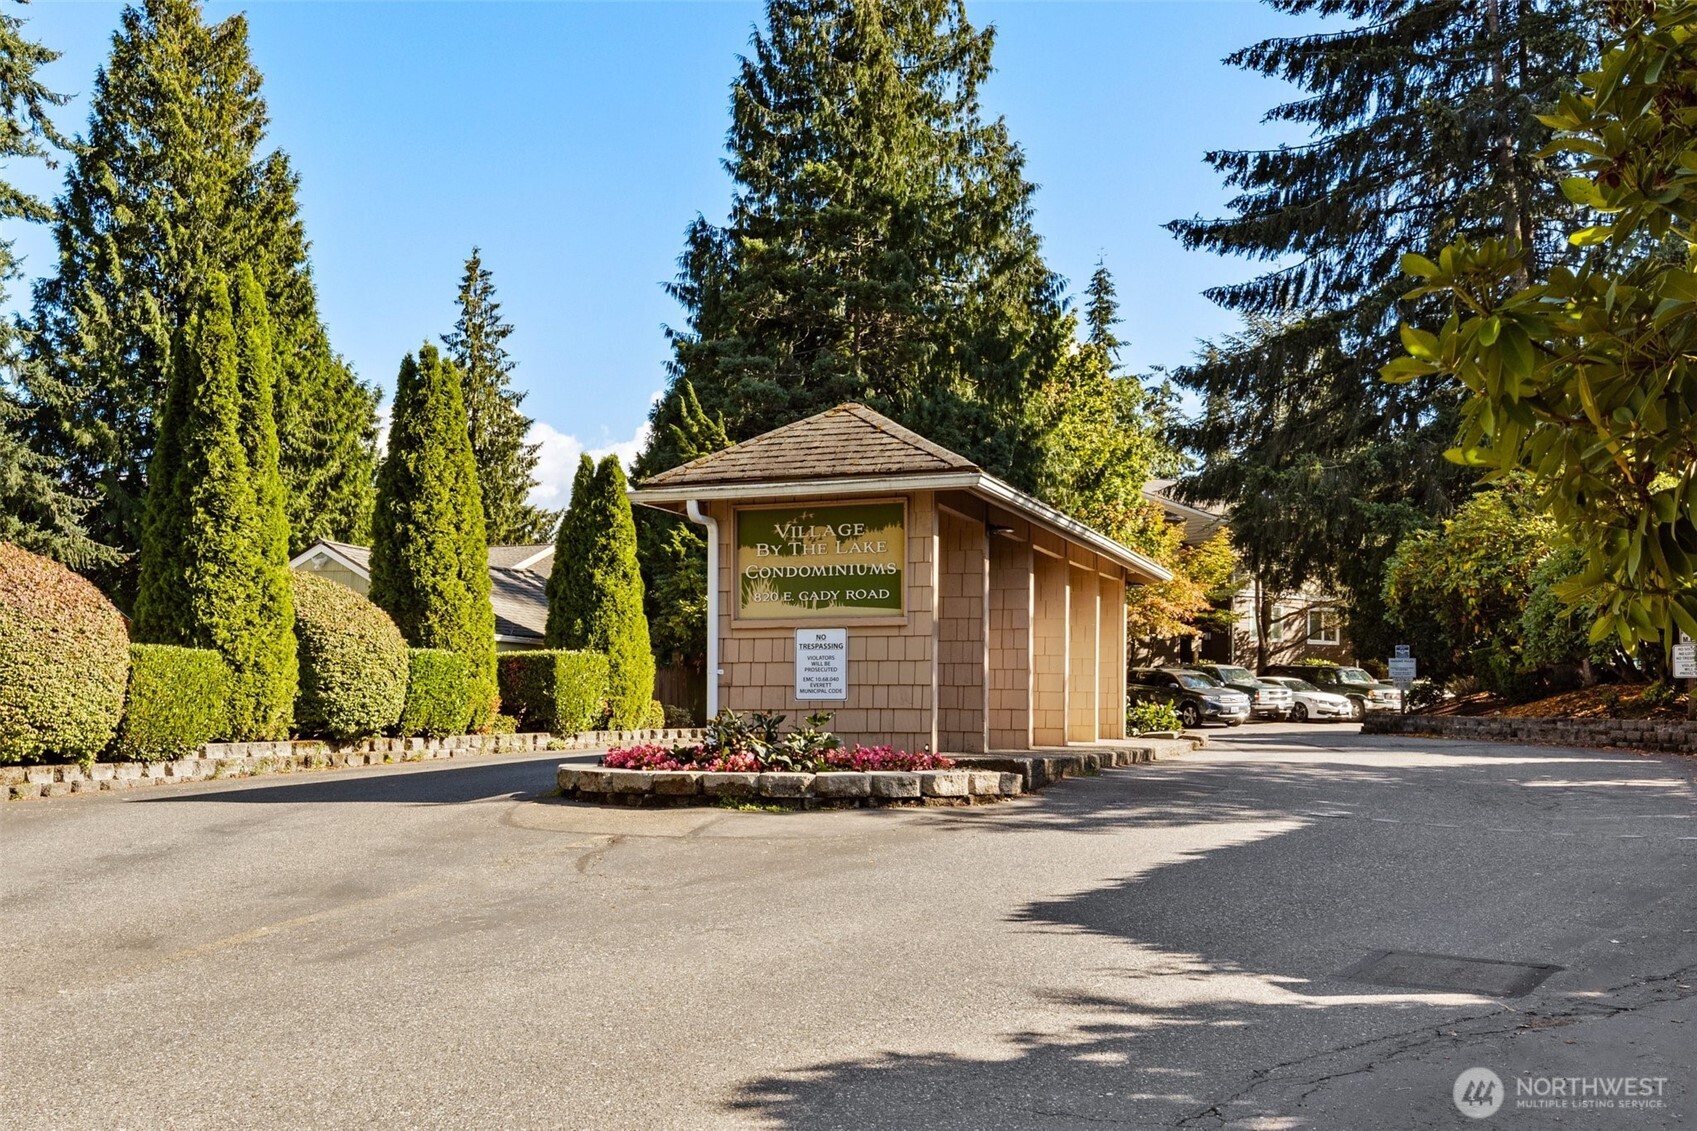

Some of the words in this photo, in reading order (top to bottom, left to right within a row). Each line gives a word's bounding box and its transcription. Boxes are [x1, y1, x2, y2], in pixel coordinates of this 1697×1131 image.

[774, 523, 865, 539] VILLAGE
[756, 543, 782, 557] BY
[788, 542, 828, 556] THE
[836, 541, 887, 554] LAKE
[745, 562, 897, 579] CONDOMINIUMS
[753, 592, 779, 603] 820
[784, 592, 794, 602] E.
[798, 590, 841, 601] CADY
[846, 589, 890, 600] ROAD
